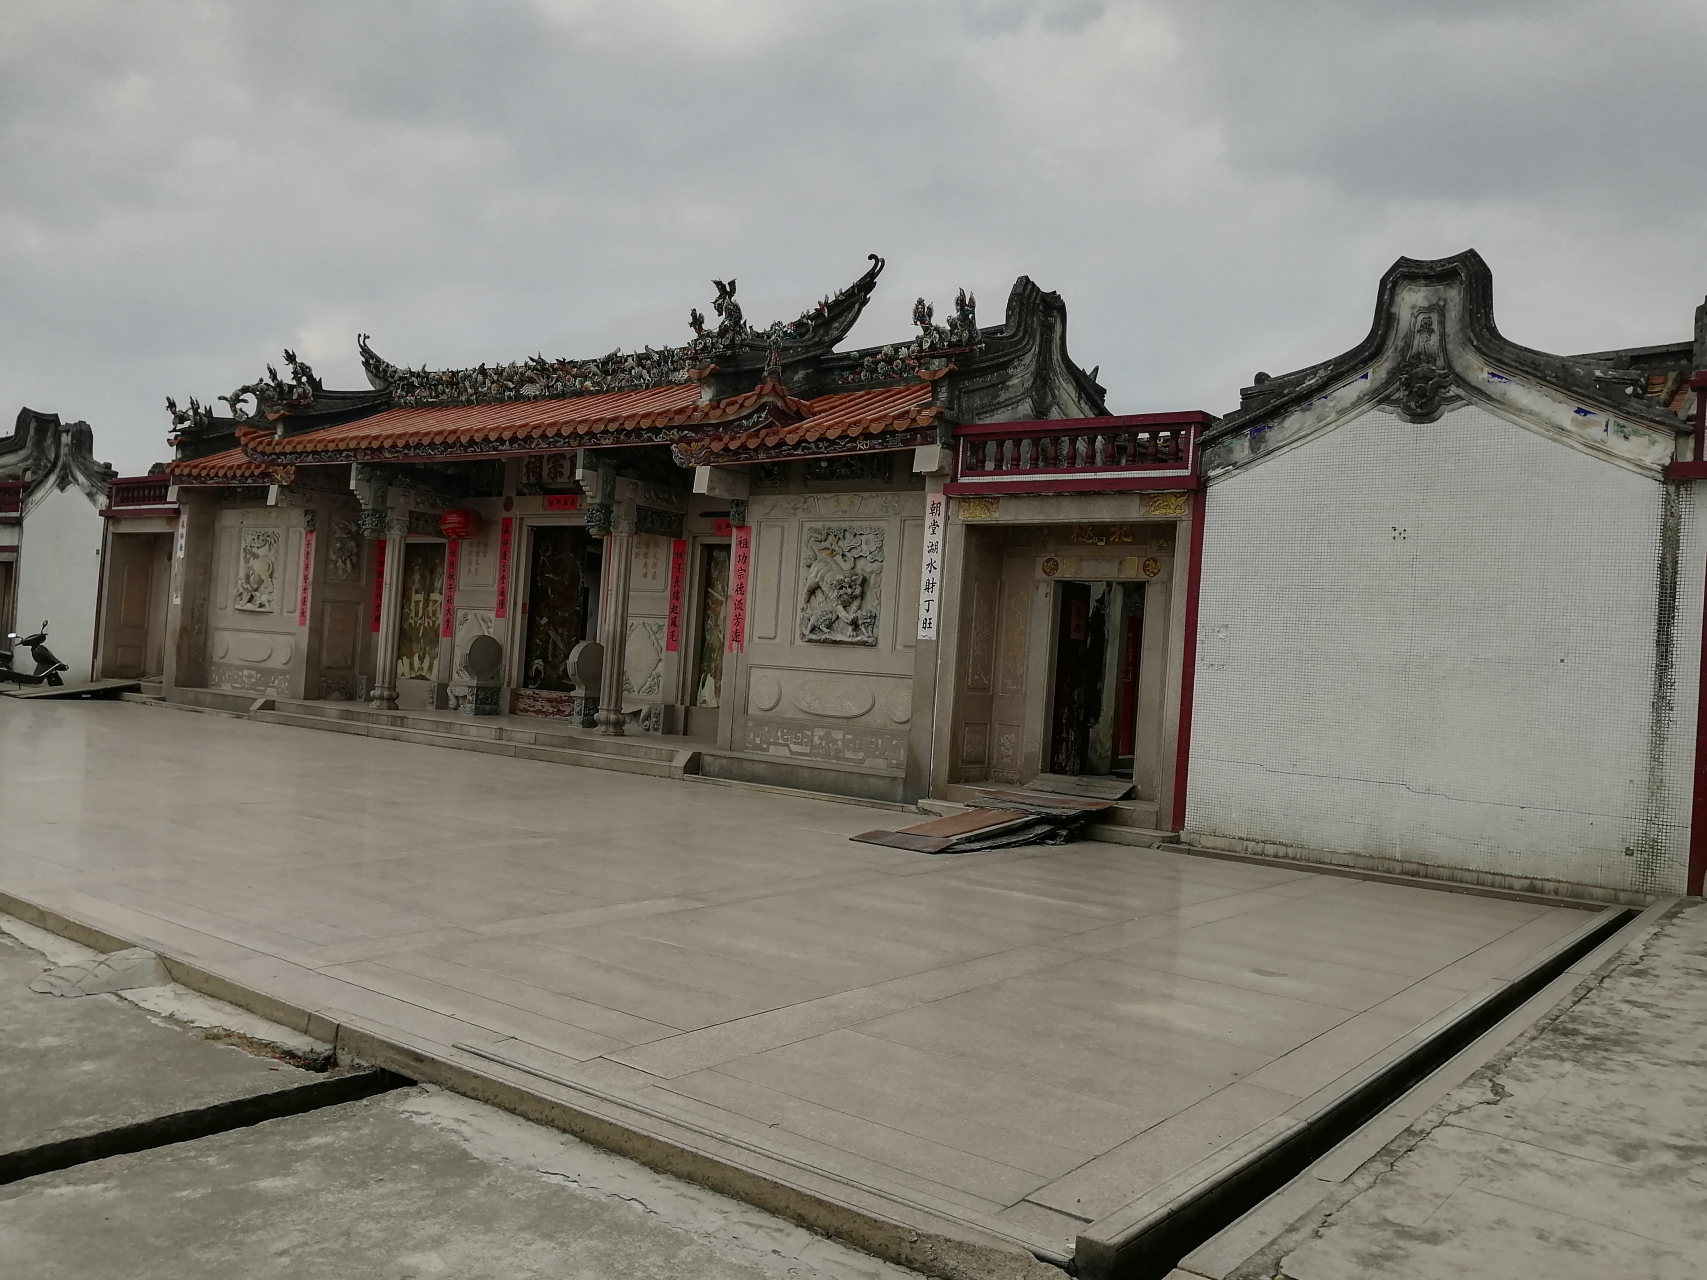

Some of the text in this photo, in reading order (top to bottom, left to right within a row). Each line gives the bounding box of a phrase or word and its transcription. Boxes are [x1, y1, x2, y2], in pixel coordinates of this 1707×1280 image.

[921, 499, 942, 631] 朝堂湖水財丁旺
